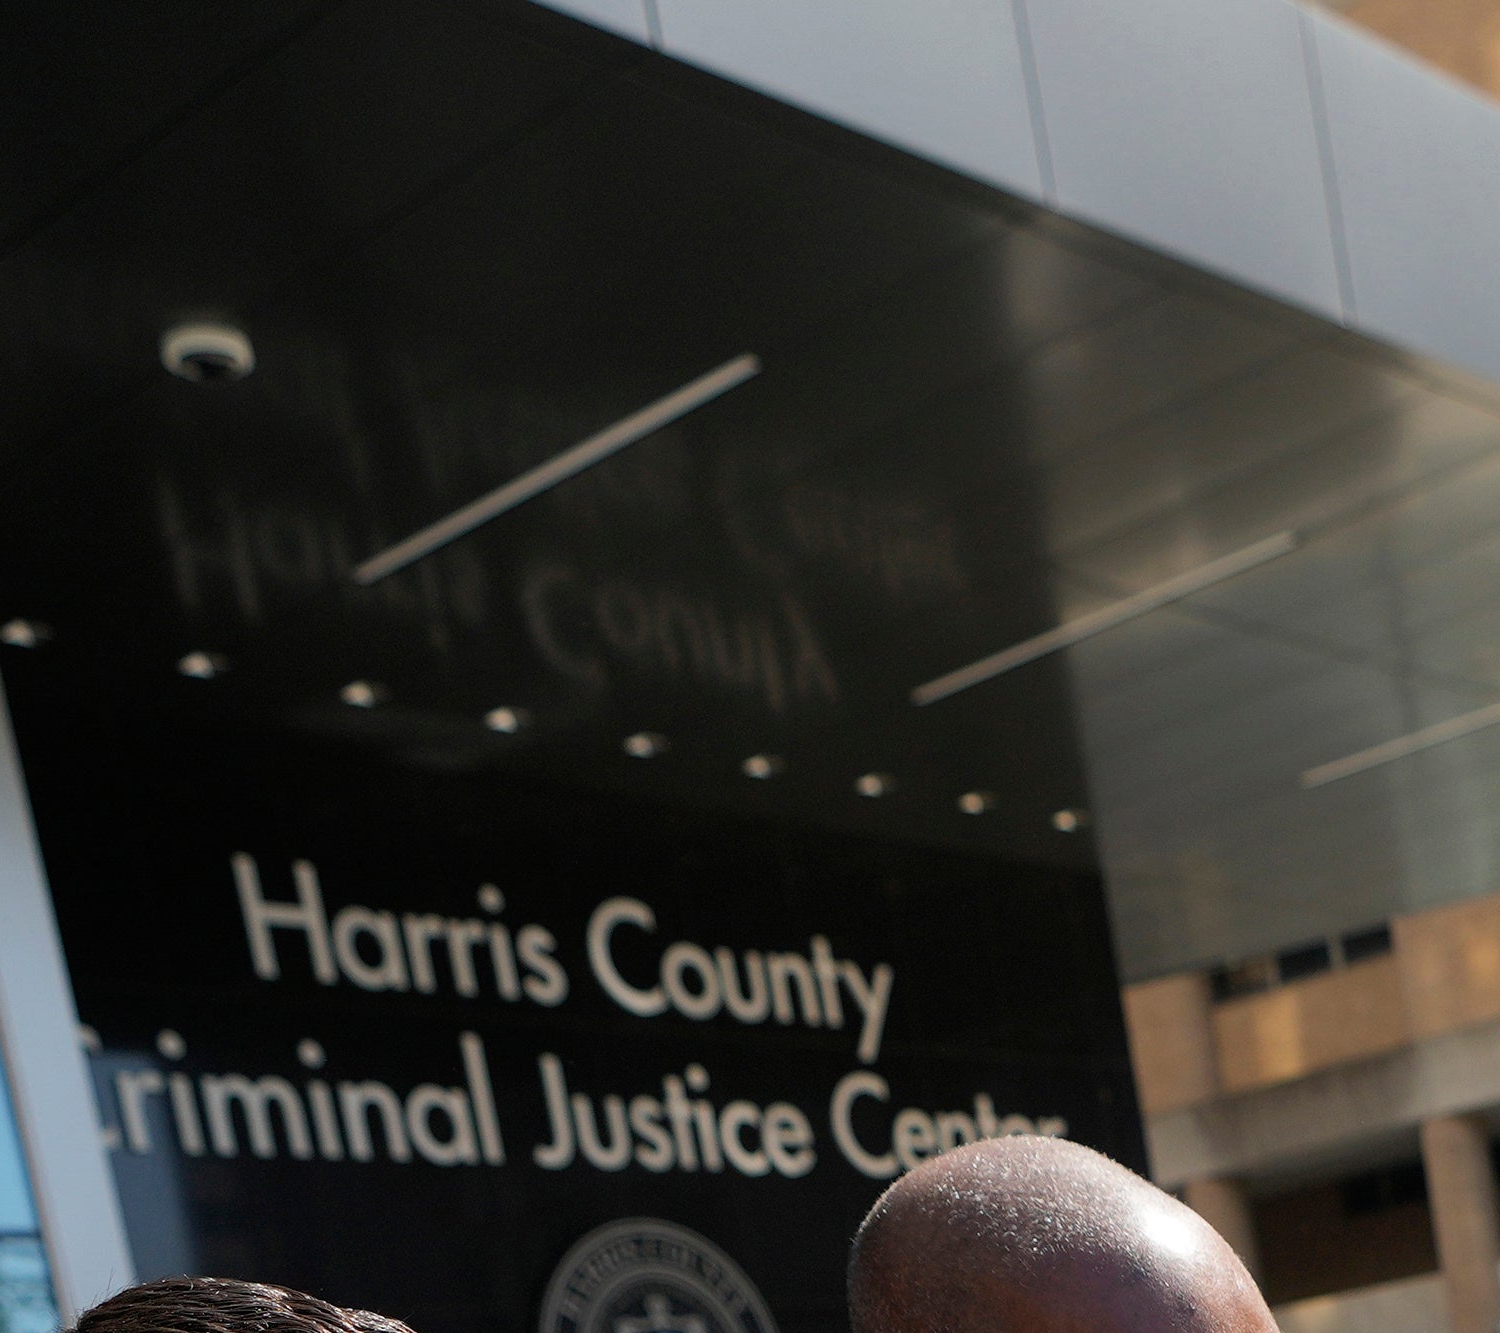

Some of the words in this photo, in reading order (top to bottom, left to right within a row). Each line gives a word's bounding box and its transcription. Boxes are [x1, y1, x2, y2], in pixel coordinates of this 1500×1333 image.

[231, 852, 569, 1006] Harris
[586, 896, 892, 1062] County
[82, 1026, 501, 1167] riminal
[533, 1053, 816, 1177] Justice
